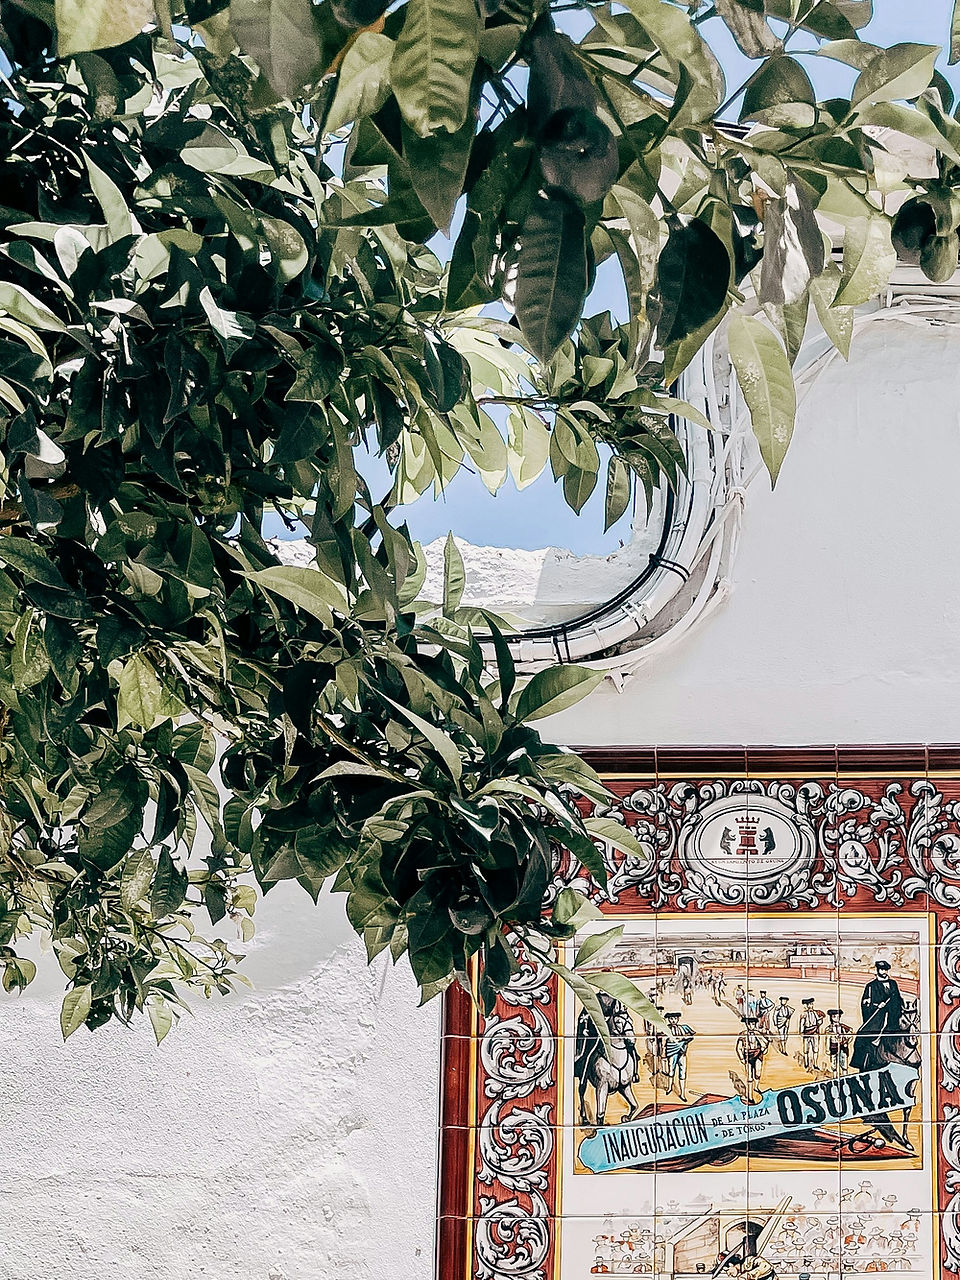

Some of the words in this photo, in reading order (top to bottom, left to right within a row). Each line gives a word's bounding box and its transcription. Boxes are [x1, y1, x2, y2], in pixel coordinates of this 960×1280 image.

[776, 1068, 906, 1128] OSUNA
[711, 1116, 724, 1128] DE
[726, 1113, 739, 1124] LA
[740, 1107, 771, 1121] PLAZA
[721, 1127, 735, 1139] DE
[736, 1121, 767, 1136] TOROS
[601, 1112, 709, 1165] INAUGURACION
